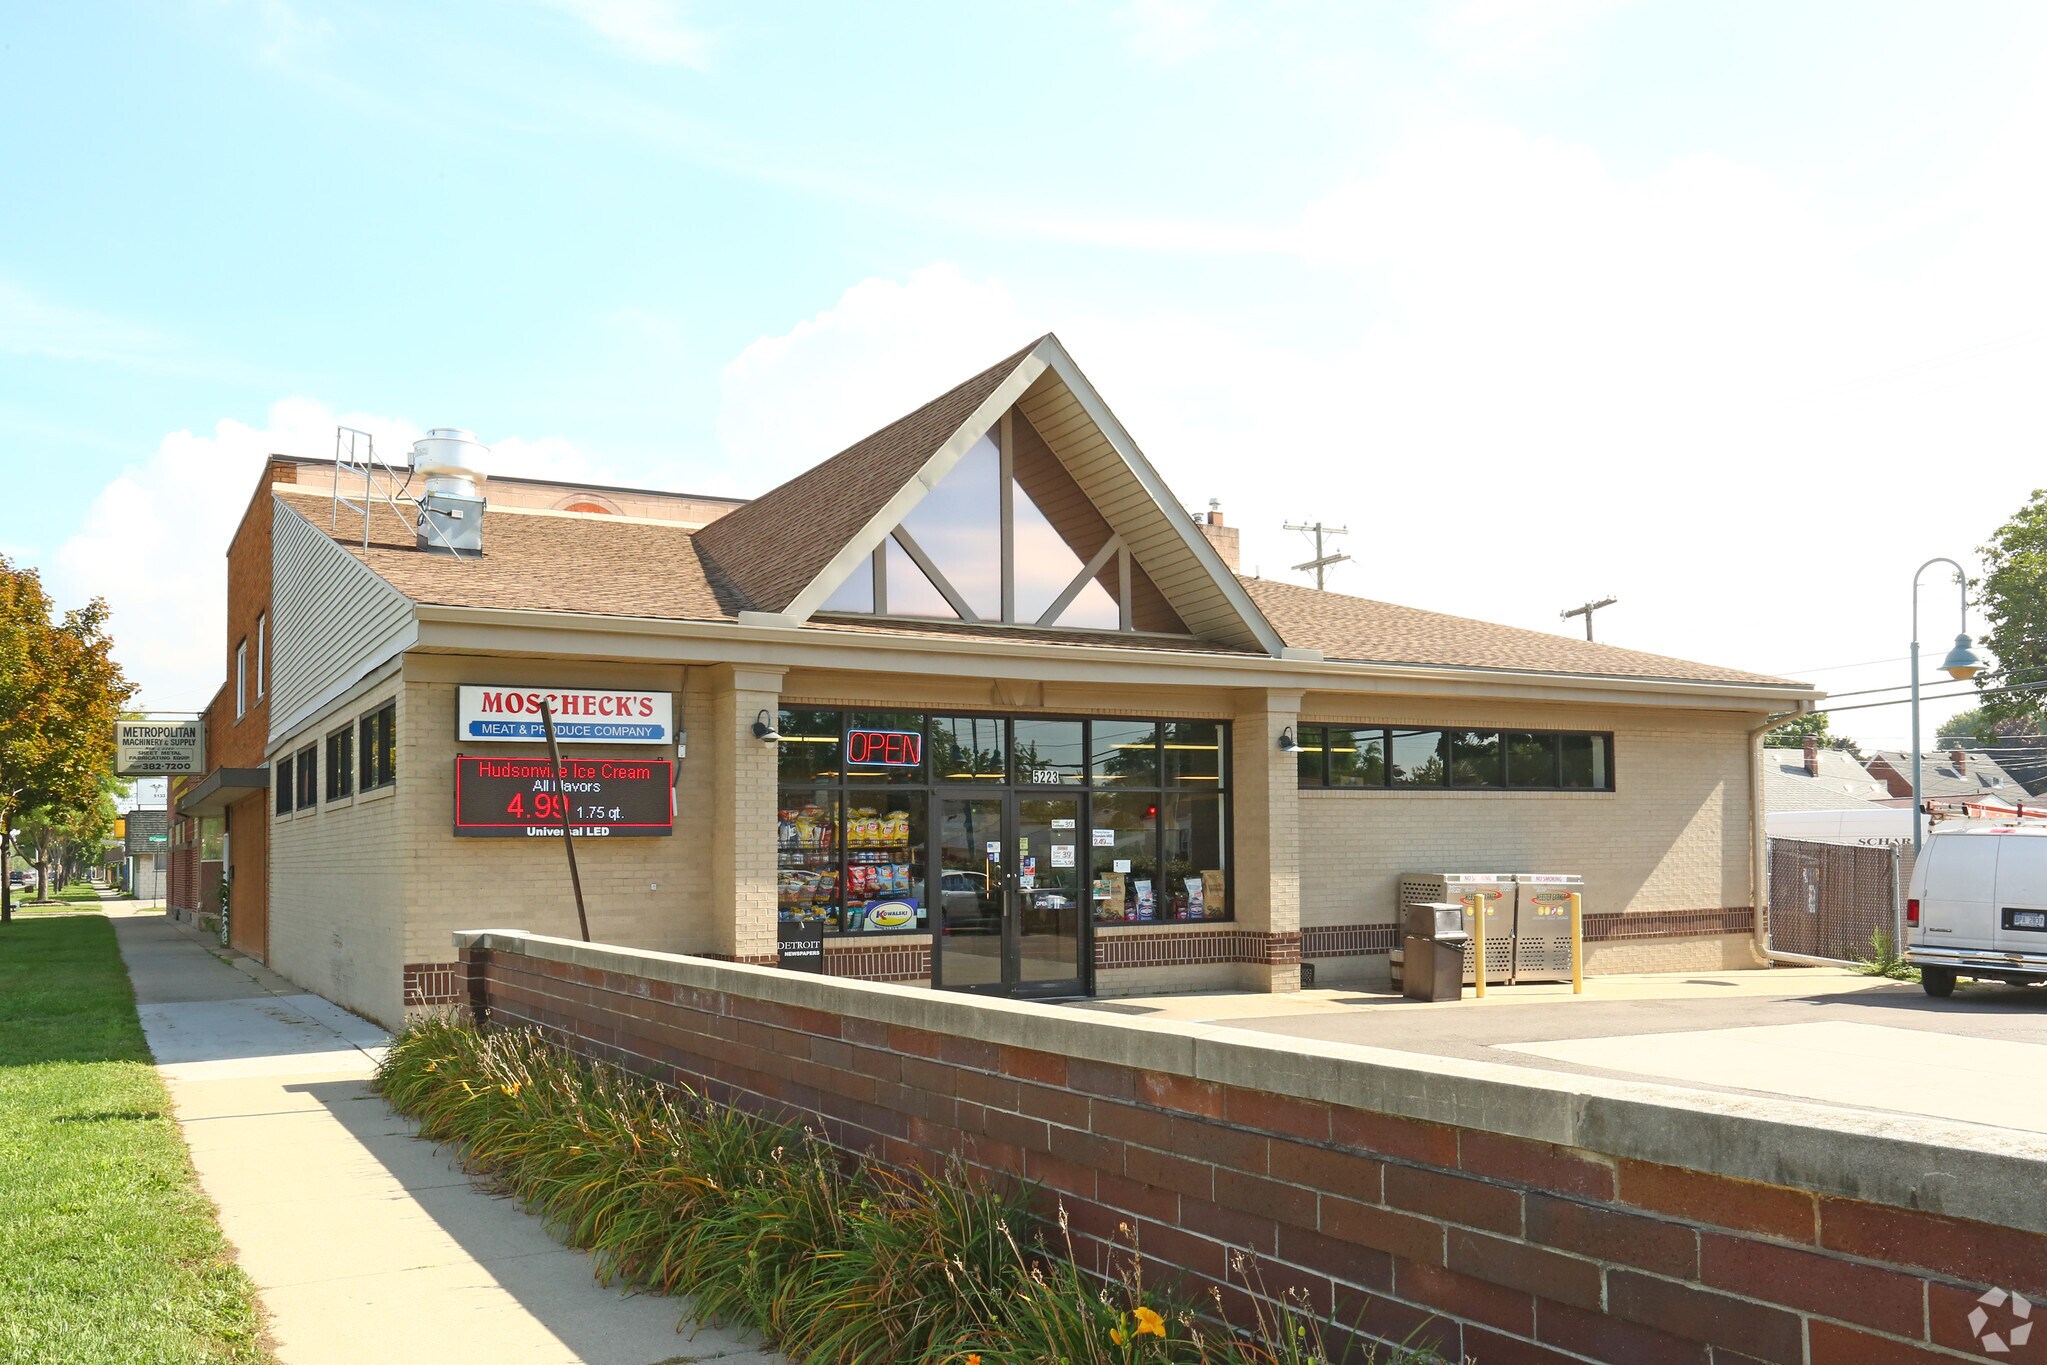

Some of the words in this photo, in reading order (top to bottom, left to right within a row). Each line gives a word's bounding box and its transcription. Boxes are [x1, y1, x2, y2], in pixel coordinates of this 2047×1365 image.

[481, 692, 654, 717] MOSCHECK'S
[123, 727, 196, 738] METROPOLITAN
[482, 723, 515, 734] MEAT
[519, 724, 528, 734] &
[594, 726, 653, 737] COMPANY
[850, 732, 920, 764] OPEN
[479, 761, 568, 778] Hudsonvie
[574, 763, 598, 778] Ice
[601, 764, 650, 779] Cream
[1034, 771, 1058, 783] 5223
[532, 779, 549, 792] All
[507, 792, 570, 819] 4.99
[576, 806, 605, 819] 1.75
[609, 807, 625, 821] qt.
[587, 827, 610, 836] LED
[876, 910, 908, 920] KOWALSKI
[777, 941, 821, 950] DETROIT
